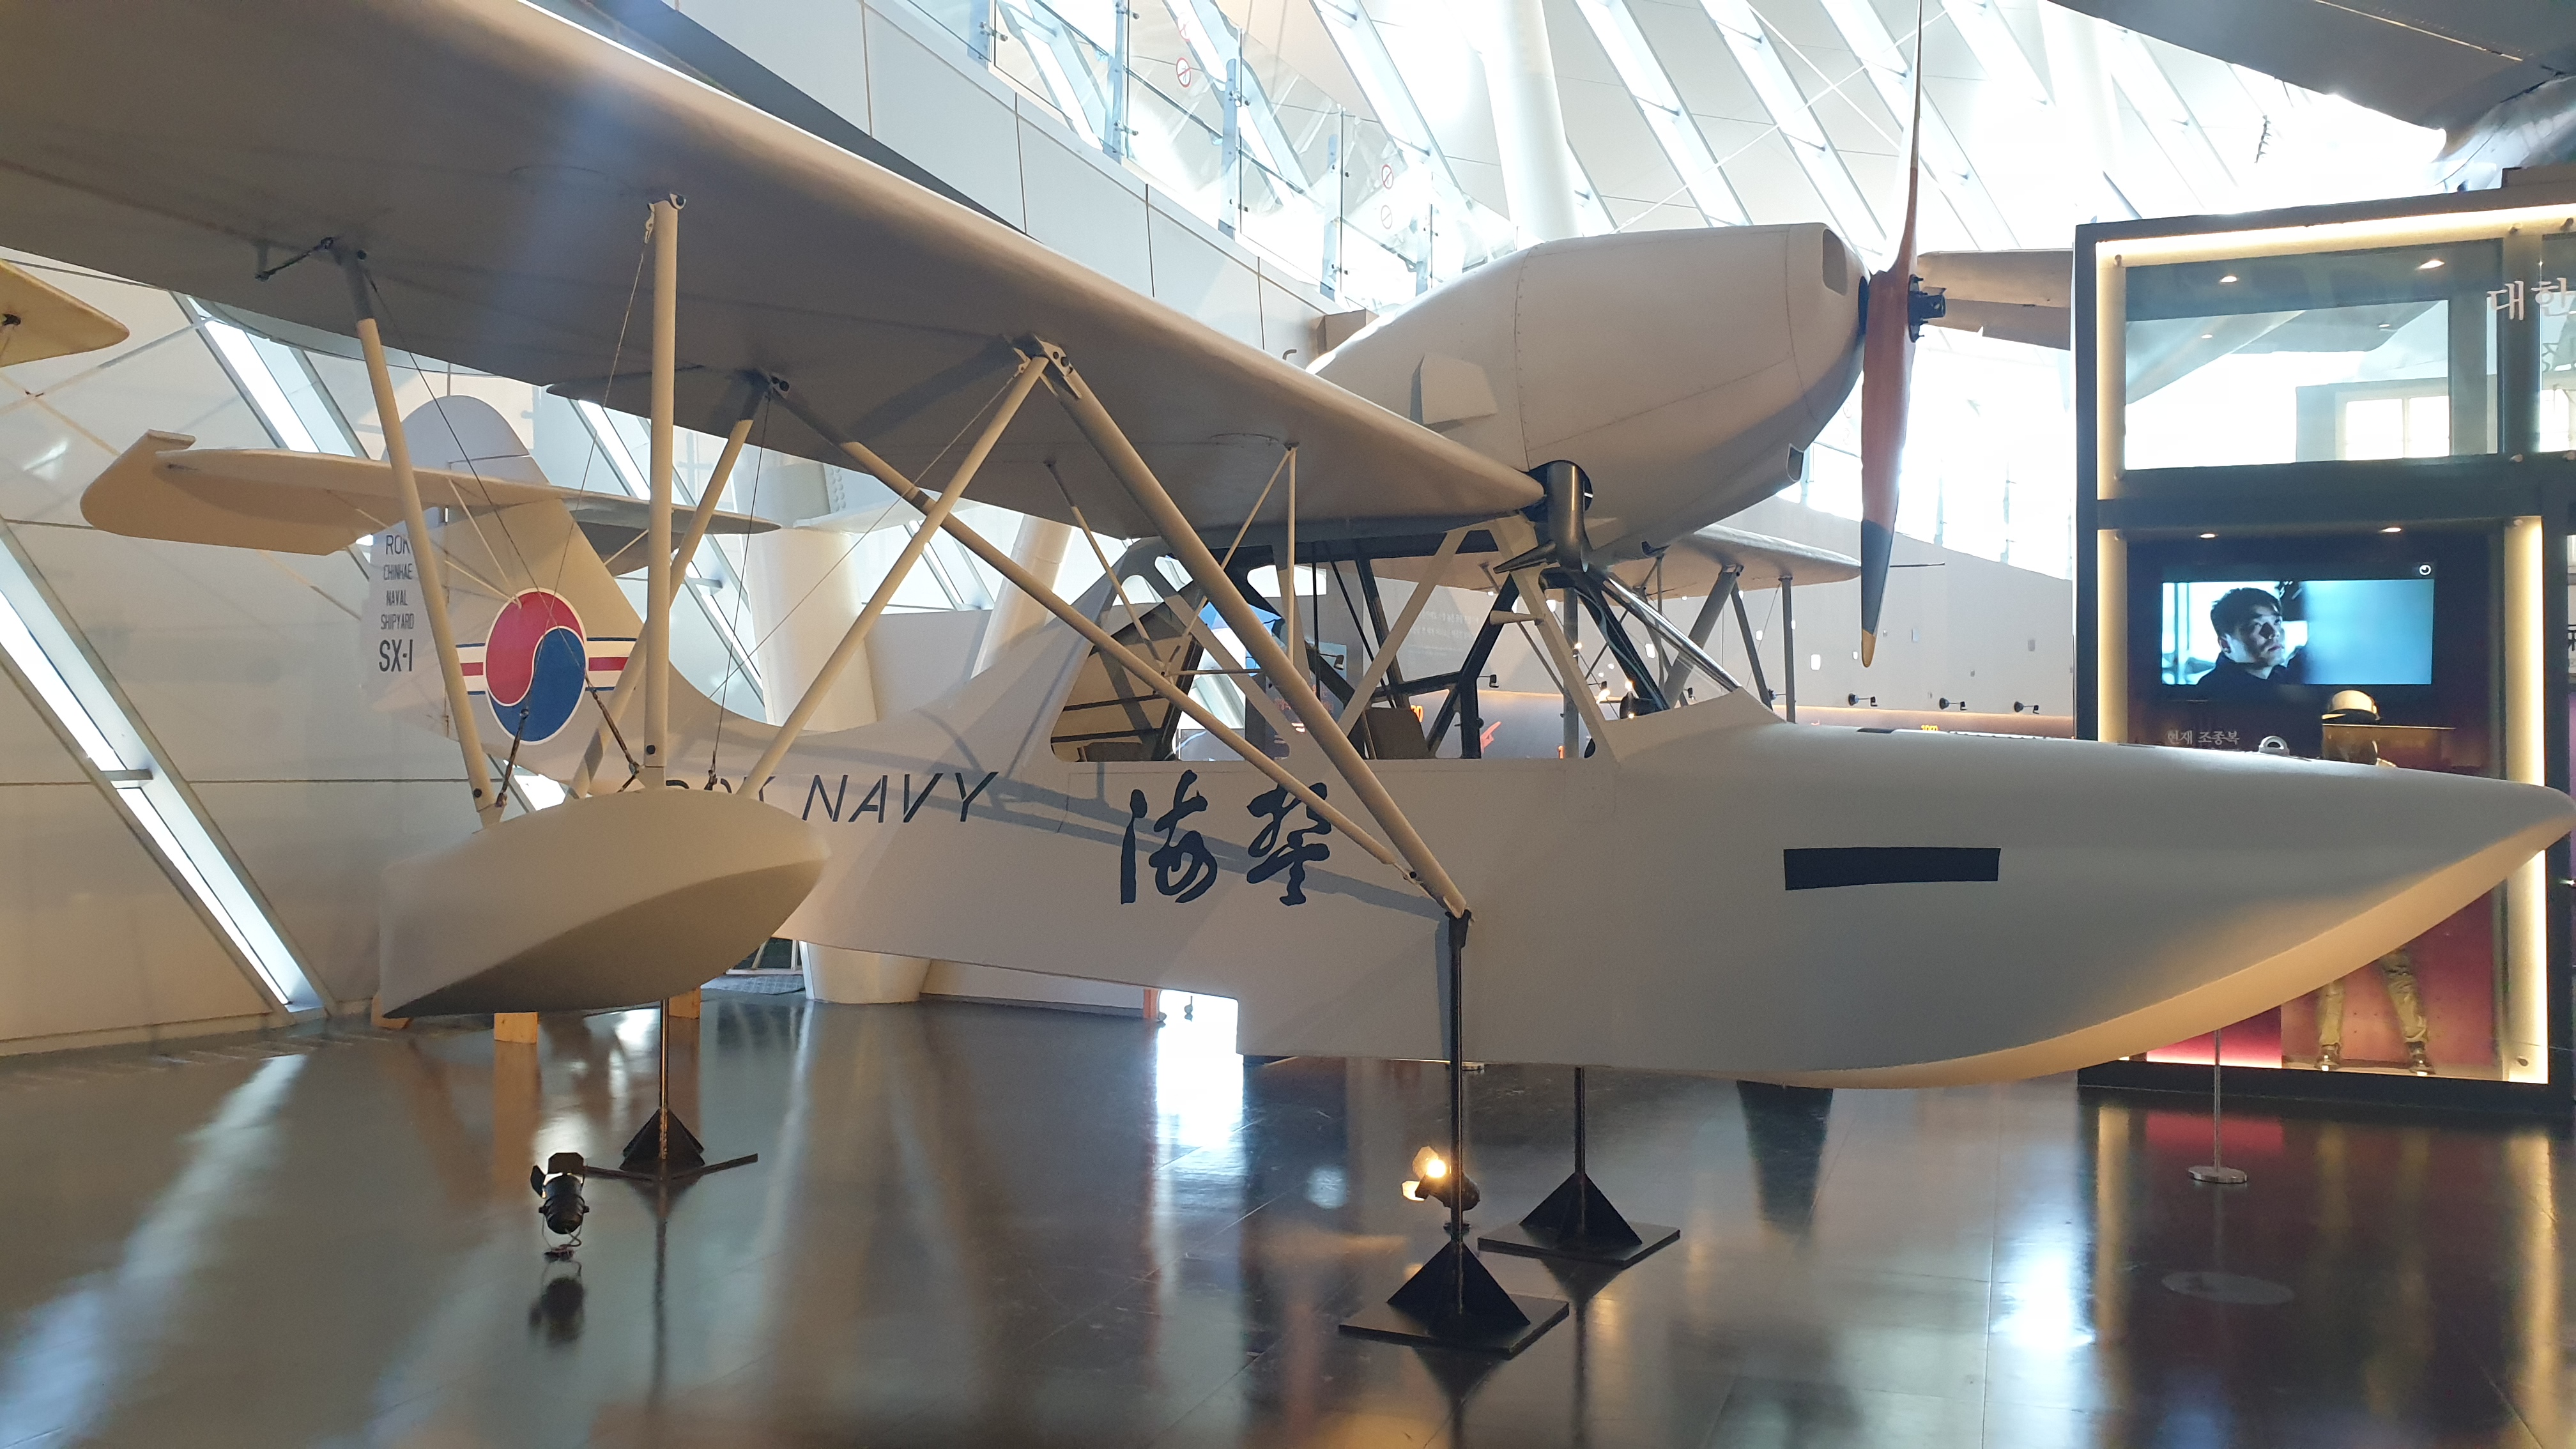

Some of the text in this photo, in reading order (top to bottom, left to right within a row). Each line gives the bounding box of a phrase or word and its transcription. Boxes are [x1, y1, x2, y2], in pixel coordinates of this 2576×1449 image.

[385, 535, 411, 555] ROK
[384, 564, 413, 580] CHINHAE
[386, 590, 408, 606] NAVAL
[380, 613, 415, 631] SHIPYARD
[2198, 730, 2240, 746] 조종복
[801, 772, 999, 824] NAVY
